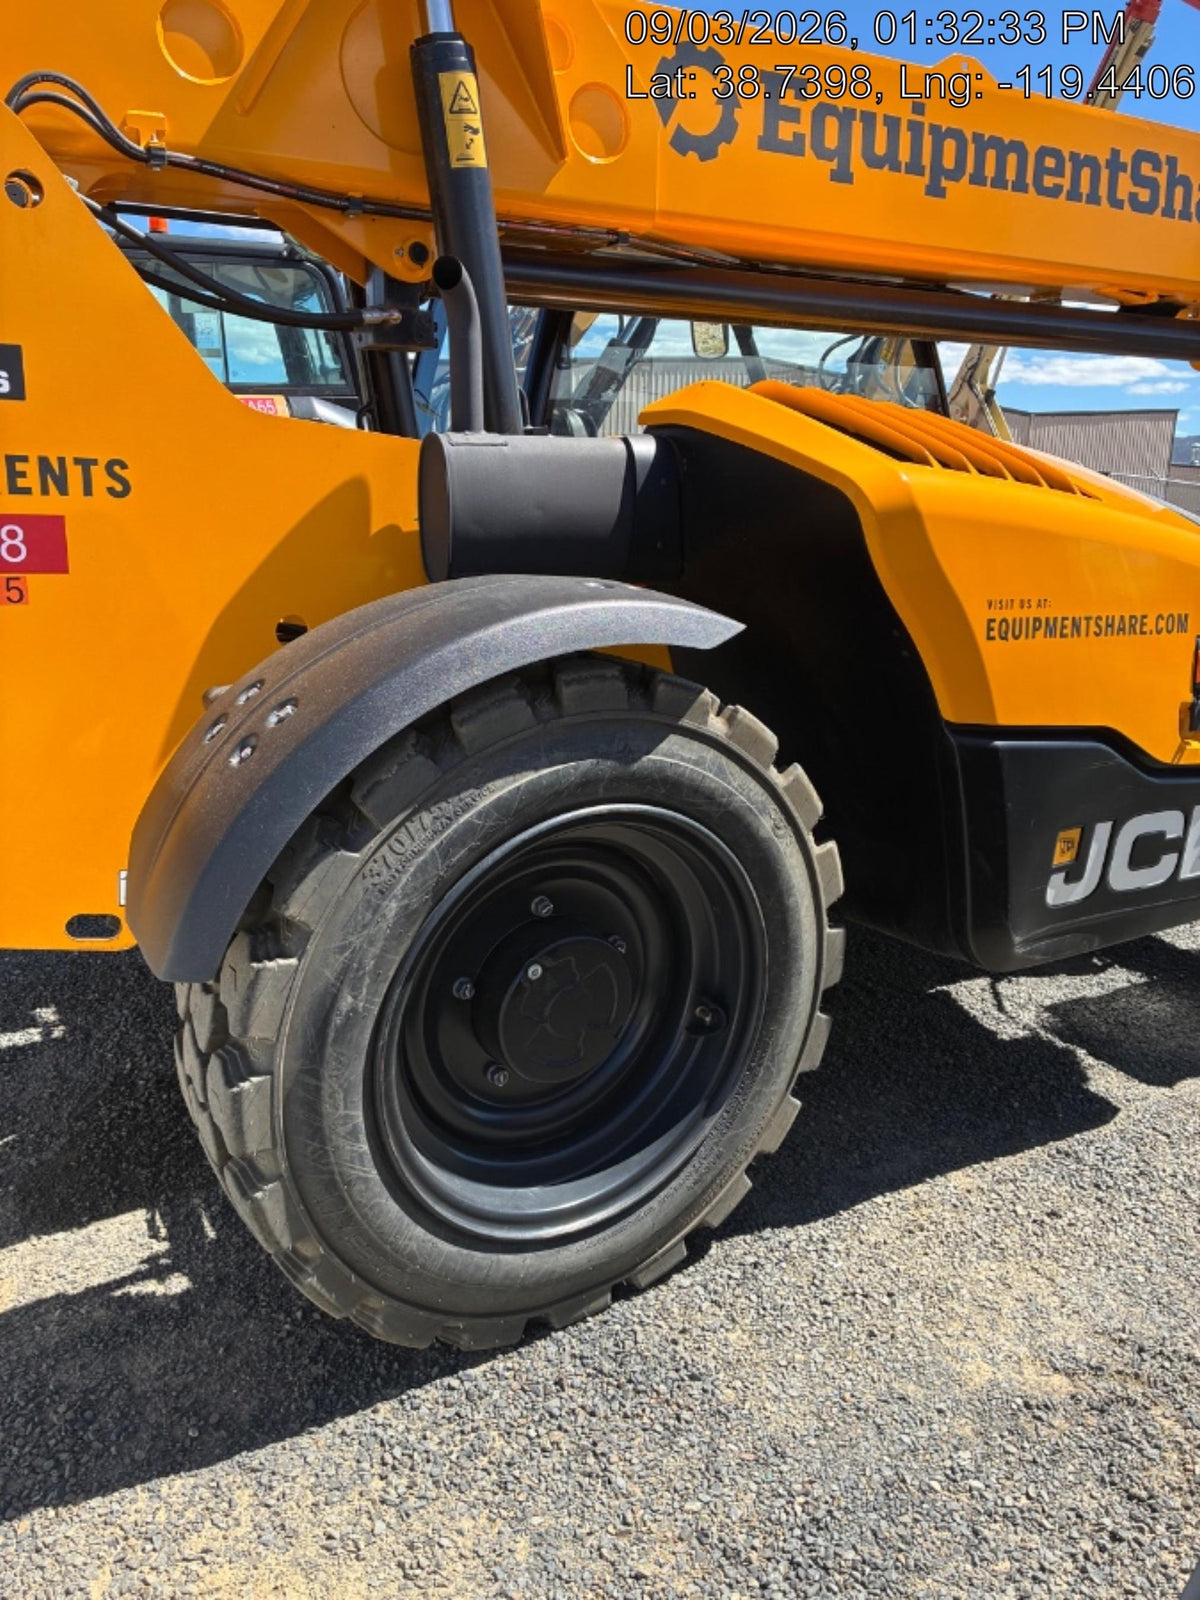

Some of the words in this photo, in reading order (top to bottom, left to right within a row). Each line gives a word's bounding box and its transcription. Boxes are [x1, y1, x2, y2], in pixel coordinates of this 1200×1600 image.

[757, 70, 1200, 223] EquipmentSh
[0, 454, 132, 498] ENTS
[0, 524, 27, 563] 8
[6, 576, 24, 603] 5
[987, 599, 1014, 611] VISIT
[1019, 599, 1032, 609] US
[1036, 598, 1052, 609] AT:
[986, 613, 1189, 642] EQUIPMENTSHARE.COM
